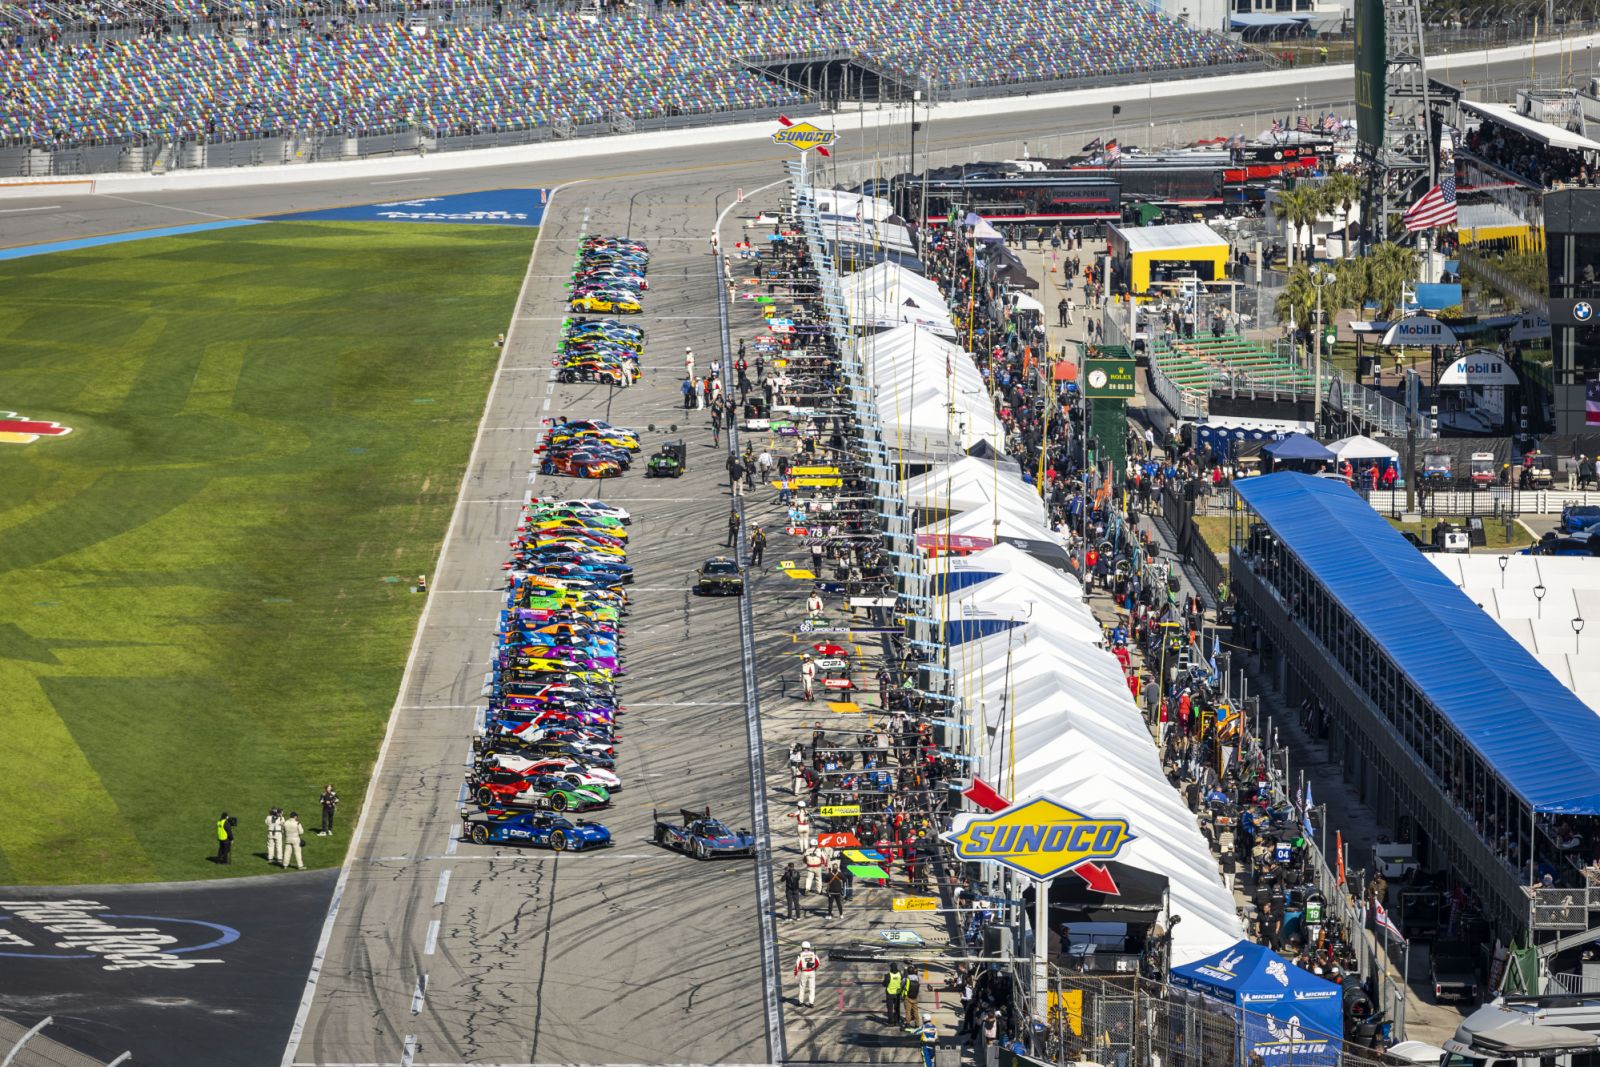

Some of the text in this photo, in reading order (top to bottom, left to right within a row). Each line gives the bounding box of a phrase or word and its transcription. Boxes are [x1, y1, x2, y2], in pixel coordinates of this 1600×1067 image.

[777, 131, 833, 142] SUNOCO
[1399, 324, 1429, 335] Mobil
[1457, 362, 1489, 373] Mobil
[811, 528, 823, 537] 78
[821, 807, 833, 815] 44
[510, 829, 530, 838] DEX
[965, 824, 1122, 852] SUNOCO
[836, 836, 847, 844] 04
[1277, 850, 1289, 858] 04
[895, 898, 905, 906] 43
[1309, 910, 1319, 919] 19
[55, 932, 226, 971] Rock
[1194, 966, 1234, 982] MICHELIN
[1253, 1043, 1326, 1056] MICHELIN
